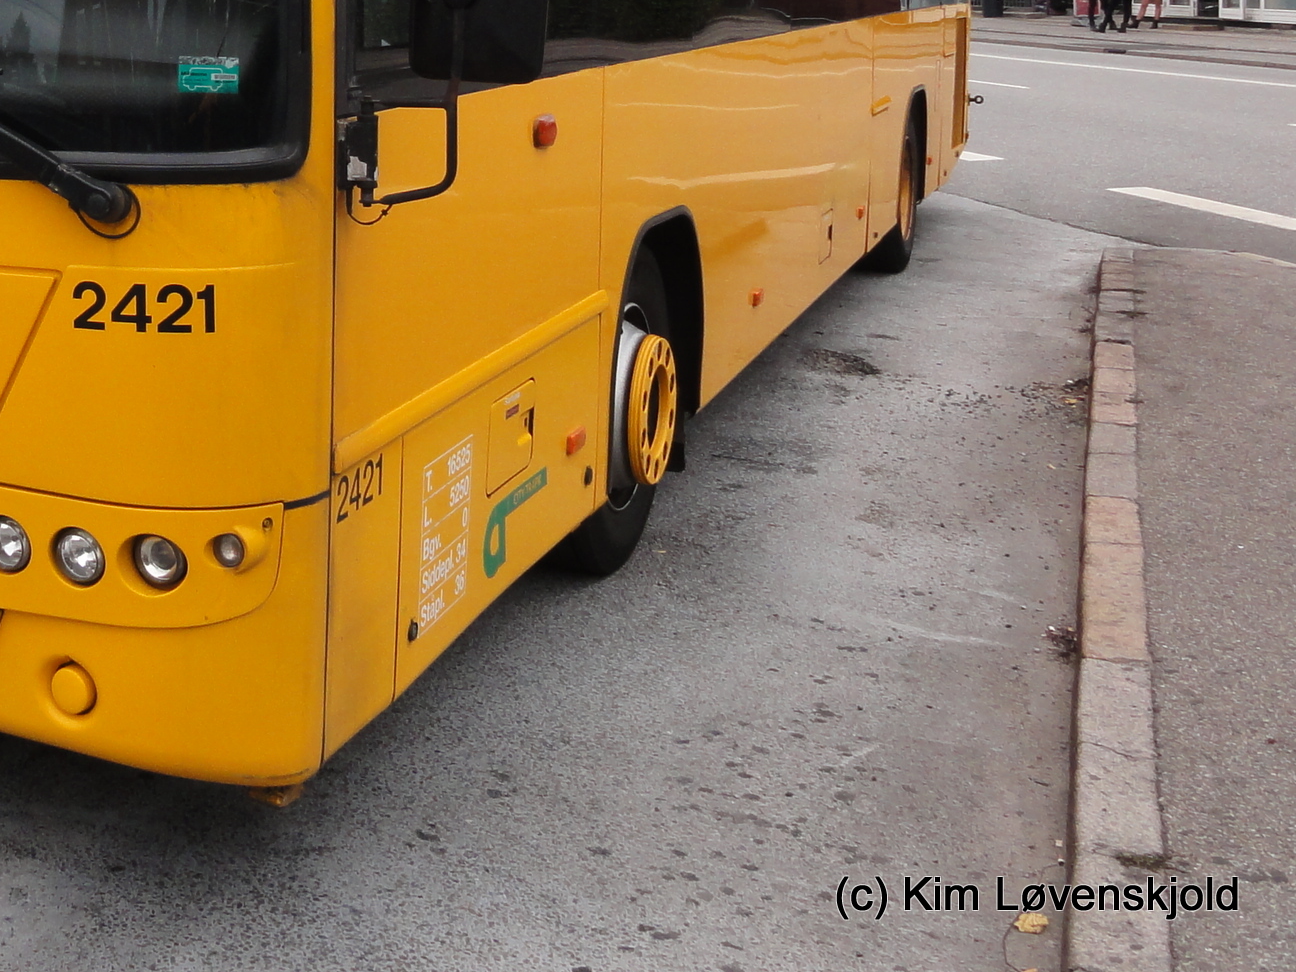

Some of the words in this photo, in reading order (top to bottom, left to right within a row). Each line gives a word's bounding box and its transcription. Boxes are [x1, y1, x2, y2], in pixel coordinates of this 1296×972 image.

[72, 281, 217, 333] 2421
[447, 444, 471, 476] 16525
[336, 453, 383, 524] 2421
[449, 475, 470, 508] 5250
[422, 534, 442, 561] Bgv.
[421, 549, 454, 594] Siddepl.
[455, 538, 466, 563] 34
[454, 570, 465, 595] 36
